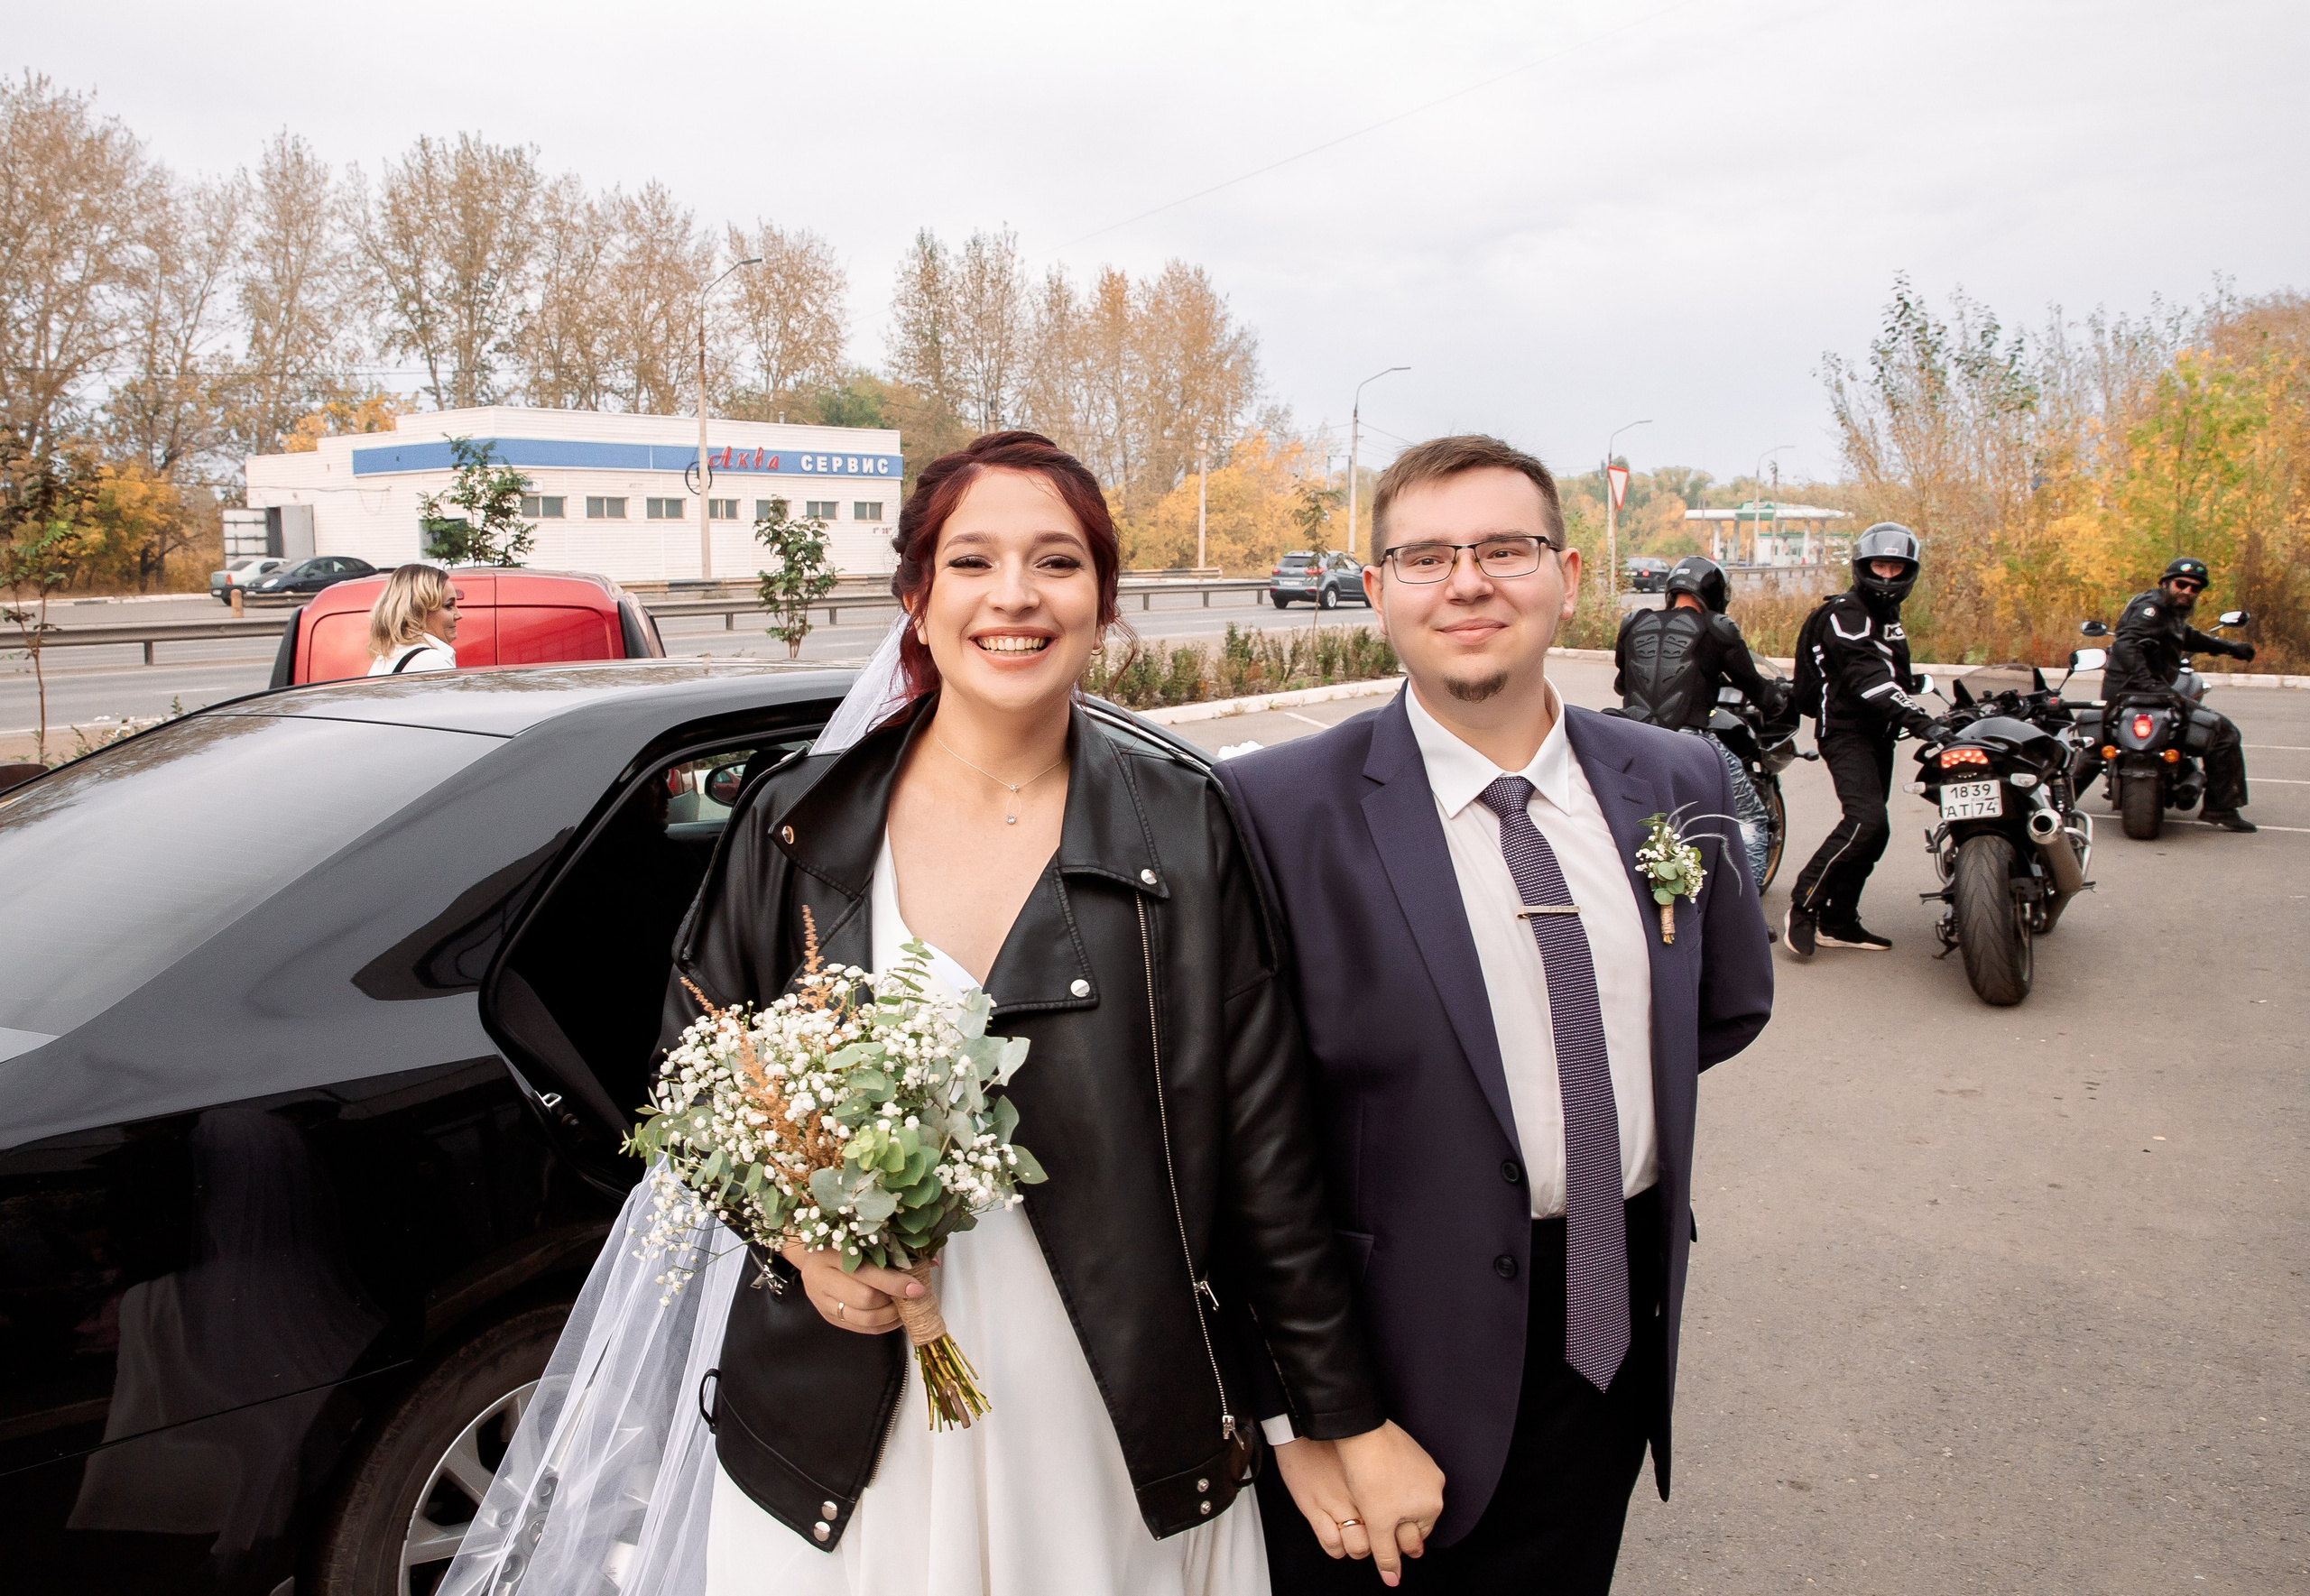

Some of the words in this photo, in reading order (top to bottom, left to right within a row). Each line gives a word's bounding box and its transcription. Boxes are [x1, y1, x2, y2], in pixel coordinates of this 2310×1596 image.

[708, 446, 779, 470] Аква
[800, 455, 889, 475] СЕРВИС
[1950, 783, 1991, 799] 1839
[1975, 801, 1996, 815] 74
